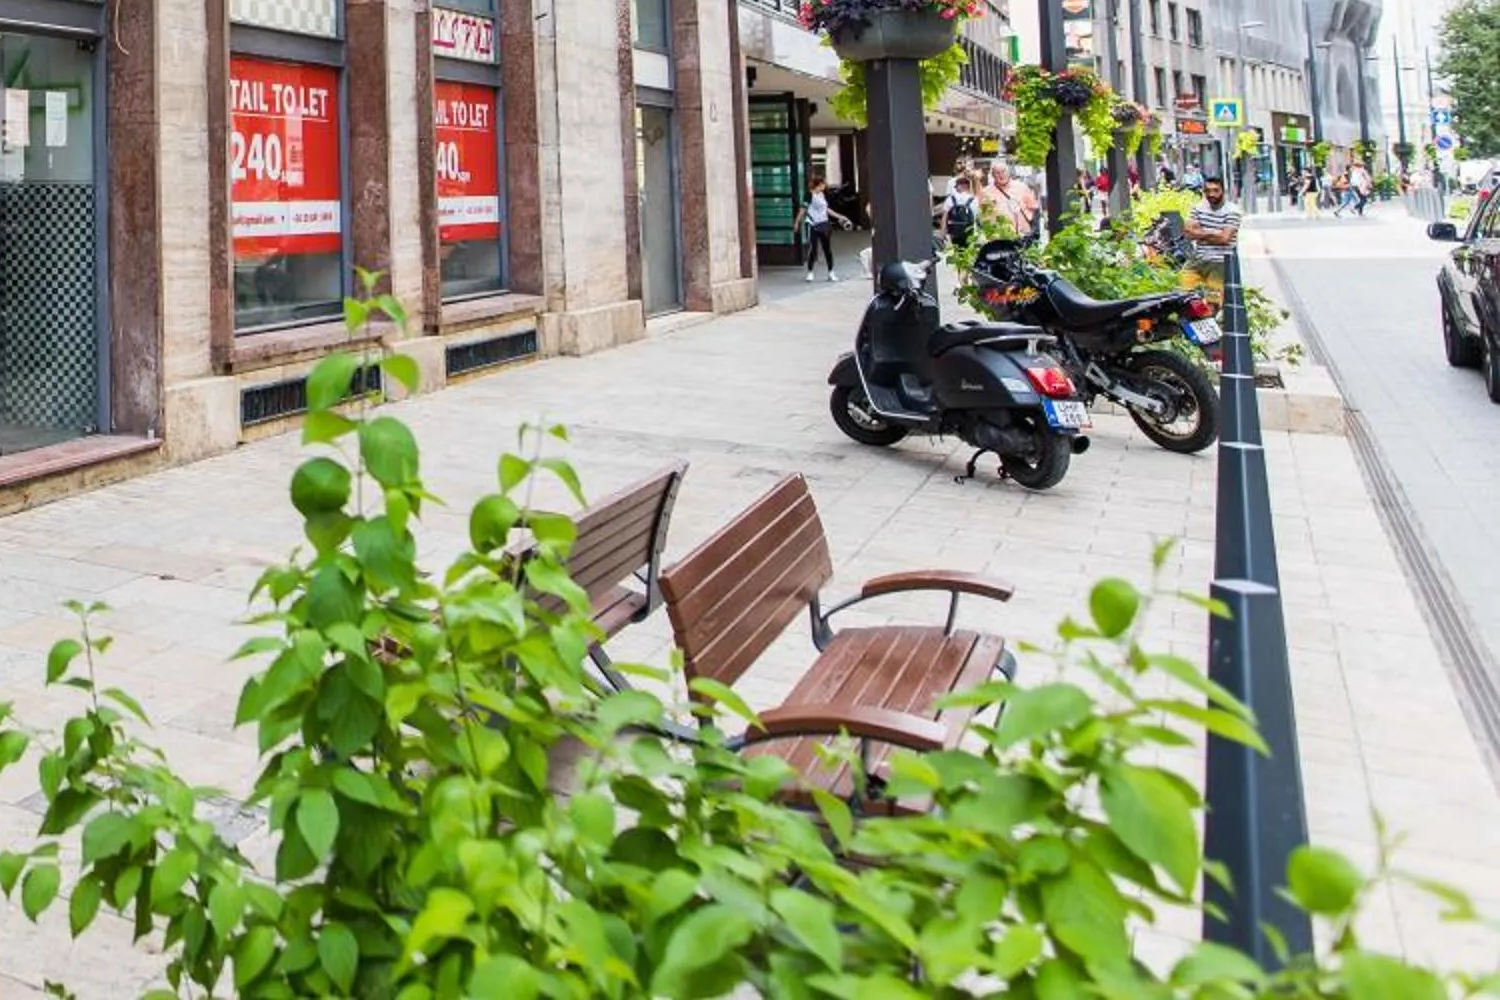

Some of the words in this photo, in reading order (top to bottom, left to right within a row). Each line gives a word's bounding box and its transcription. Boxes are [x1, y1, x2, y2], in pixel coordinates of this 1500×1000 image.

[272, 83, 297, 115] TO
[300, 86, 328, 117] LET
[451, 100, 467, 126] TO
[469, 103, 489, 128] LET
